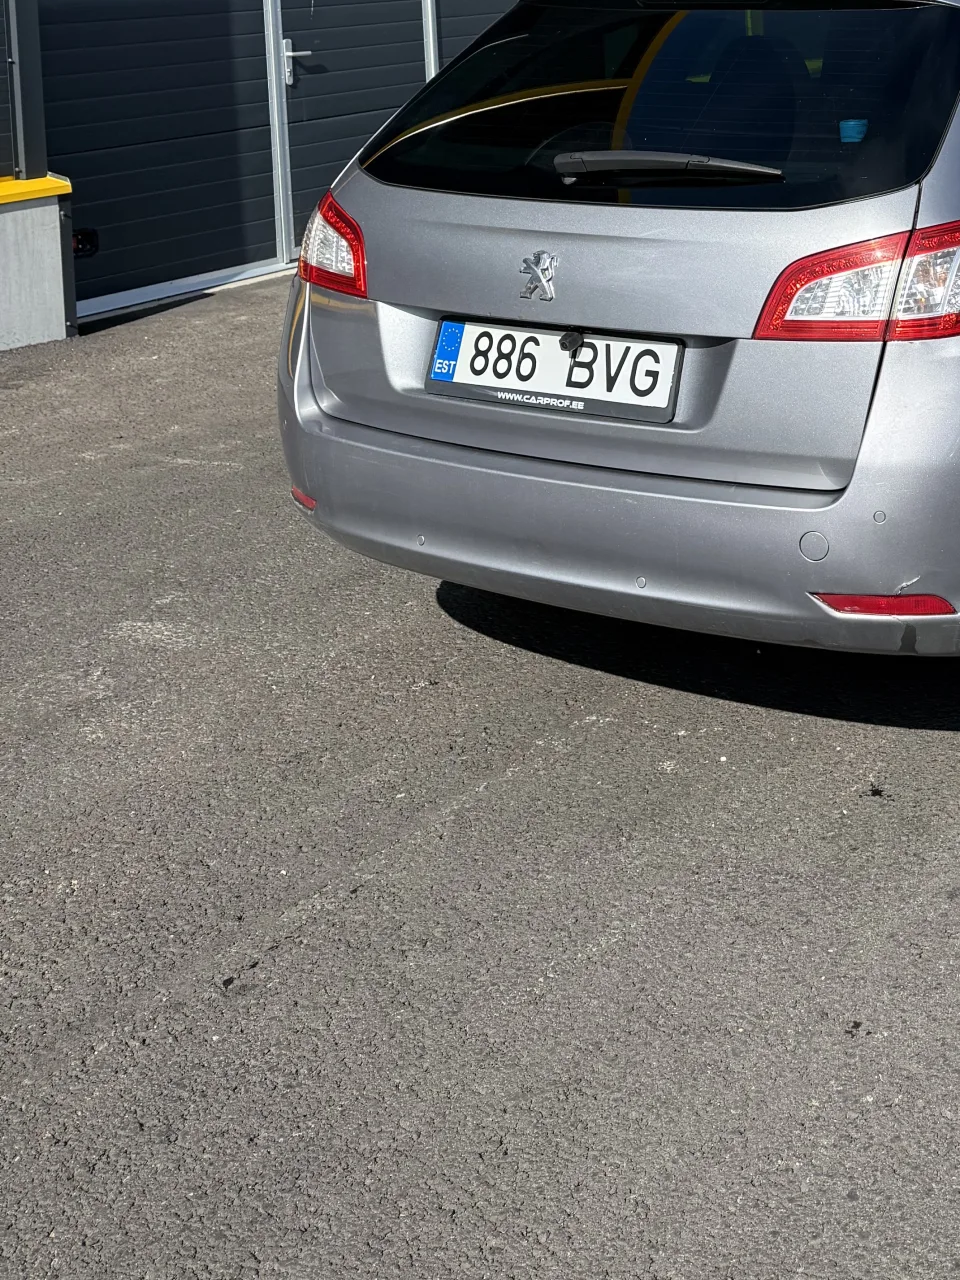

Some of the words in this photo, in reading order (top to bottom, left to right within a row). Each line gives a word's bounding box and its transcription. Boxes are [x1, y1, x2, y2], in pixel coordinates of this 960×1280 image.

[434, 358, 456, 375] EST
[469, 330, 541, 382] 886
[566, 340, 661, 398] BVG
[497, 391, 585, 410] WWW.CARPROF.EE
